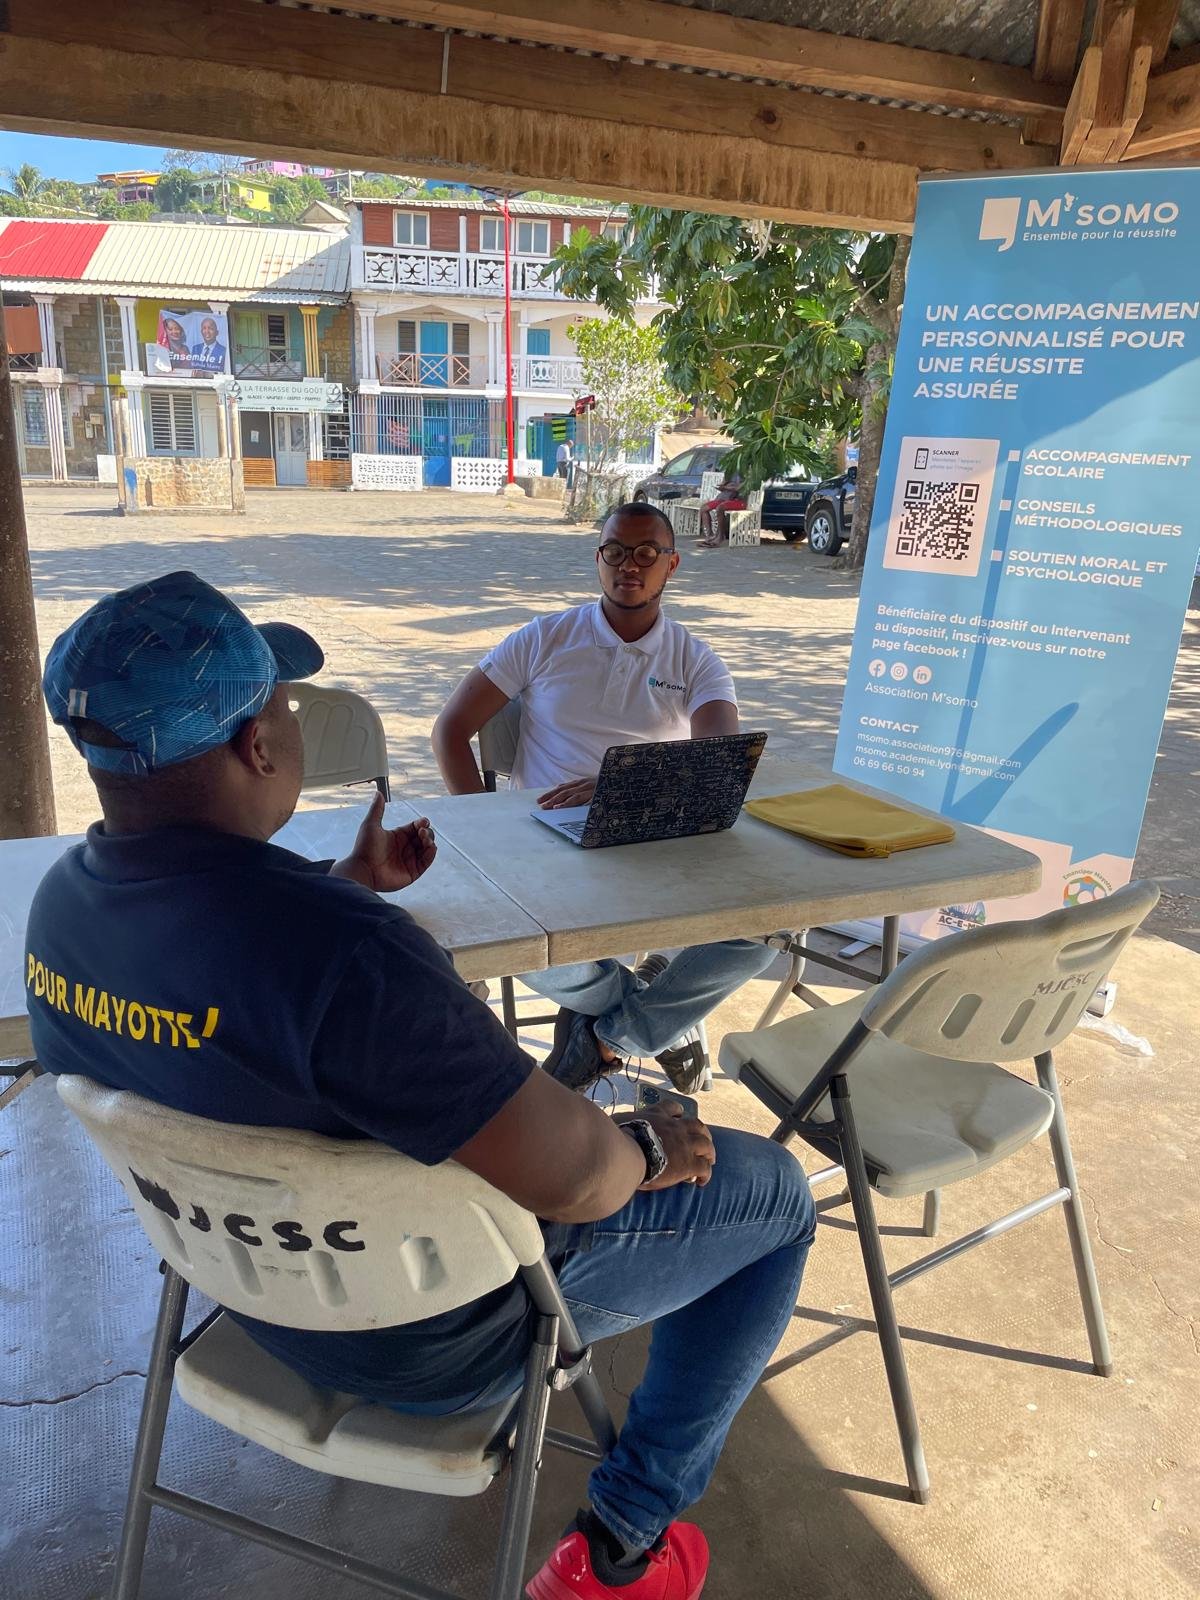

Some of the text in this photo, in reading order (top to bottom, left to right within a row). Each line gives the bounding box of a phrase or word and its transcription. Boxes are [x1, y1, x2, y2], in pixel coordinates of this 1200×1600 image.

[1023, 228, 1177, 241] Ensemble pour la réussite
[926, 301, 1200, 321] UN ACCOMPAGNEMEN
[921, 327, 1185, 348] PERSONNALISÉ POUR
[918, 353, 1084, 375] UNE RÉUSSITE
[913, 379, 1018, 400] ASSURÉE
[1026, 449, 1191, 467] ACCOMPAGNEMENT
[1023, 464, 1105, 480] SCOLAIRE
[1017, 500, 1096, 514] CONSEILS
[1014, 513, 1183, 537] MÉTHODOLOGIQUES
[1008, 550, 1168, 574] SOUTIEN MORAL ET
[1005, 565, 1144, 588] PSYCHOLOGIQUE
[877, 604, 947, 623] Bénéficiaire
[950, 613, 967, 625] du
[969, 616, 1028, 635] dispositif
[1031, 625, 1048, 635] ou
[872, 638, 967, 659] page facebook !
[874, 623, 1106, 660] au dispositif, inscrivez-vous sur notre
[864, 681, 979, 709] Association M'somo
[859, 716, 920, 734] CONTACT
[853, 756, 925, 778] 06 69 66 50 94
[27, 953, 70, 1013] POUR
[74, 983, 200, 1048] MAYOTTE
